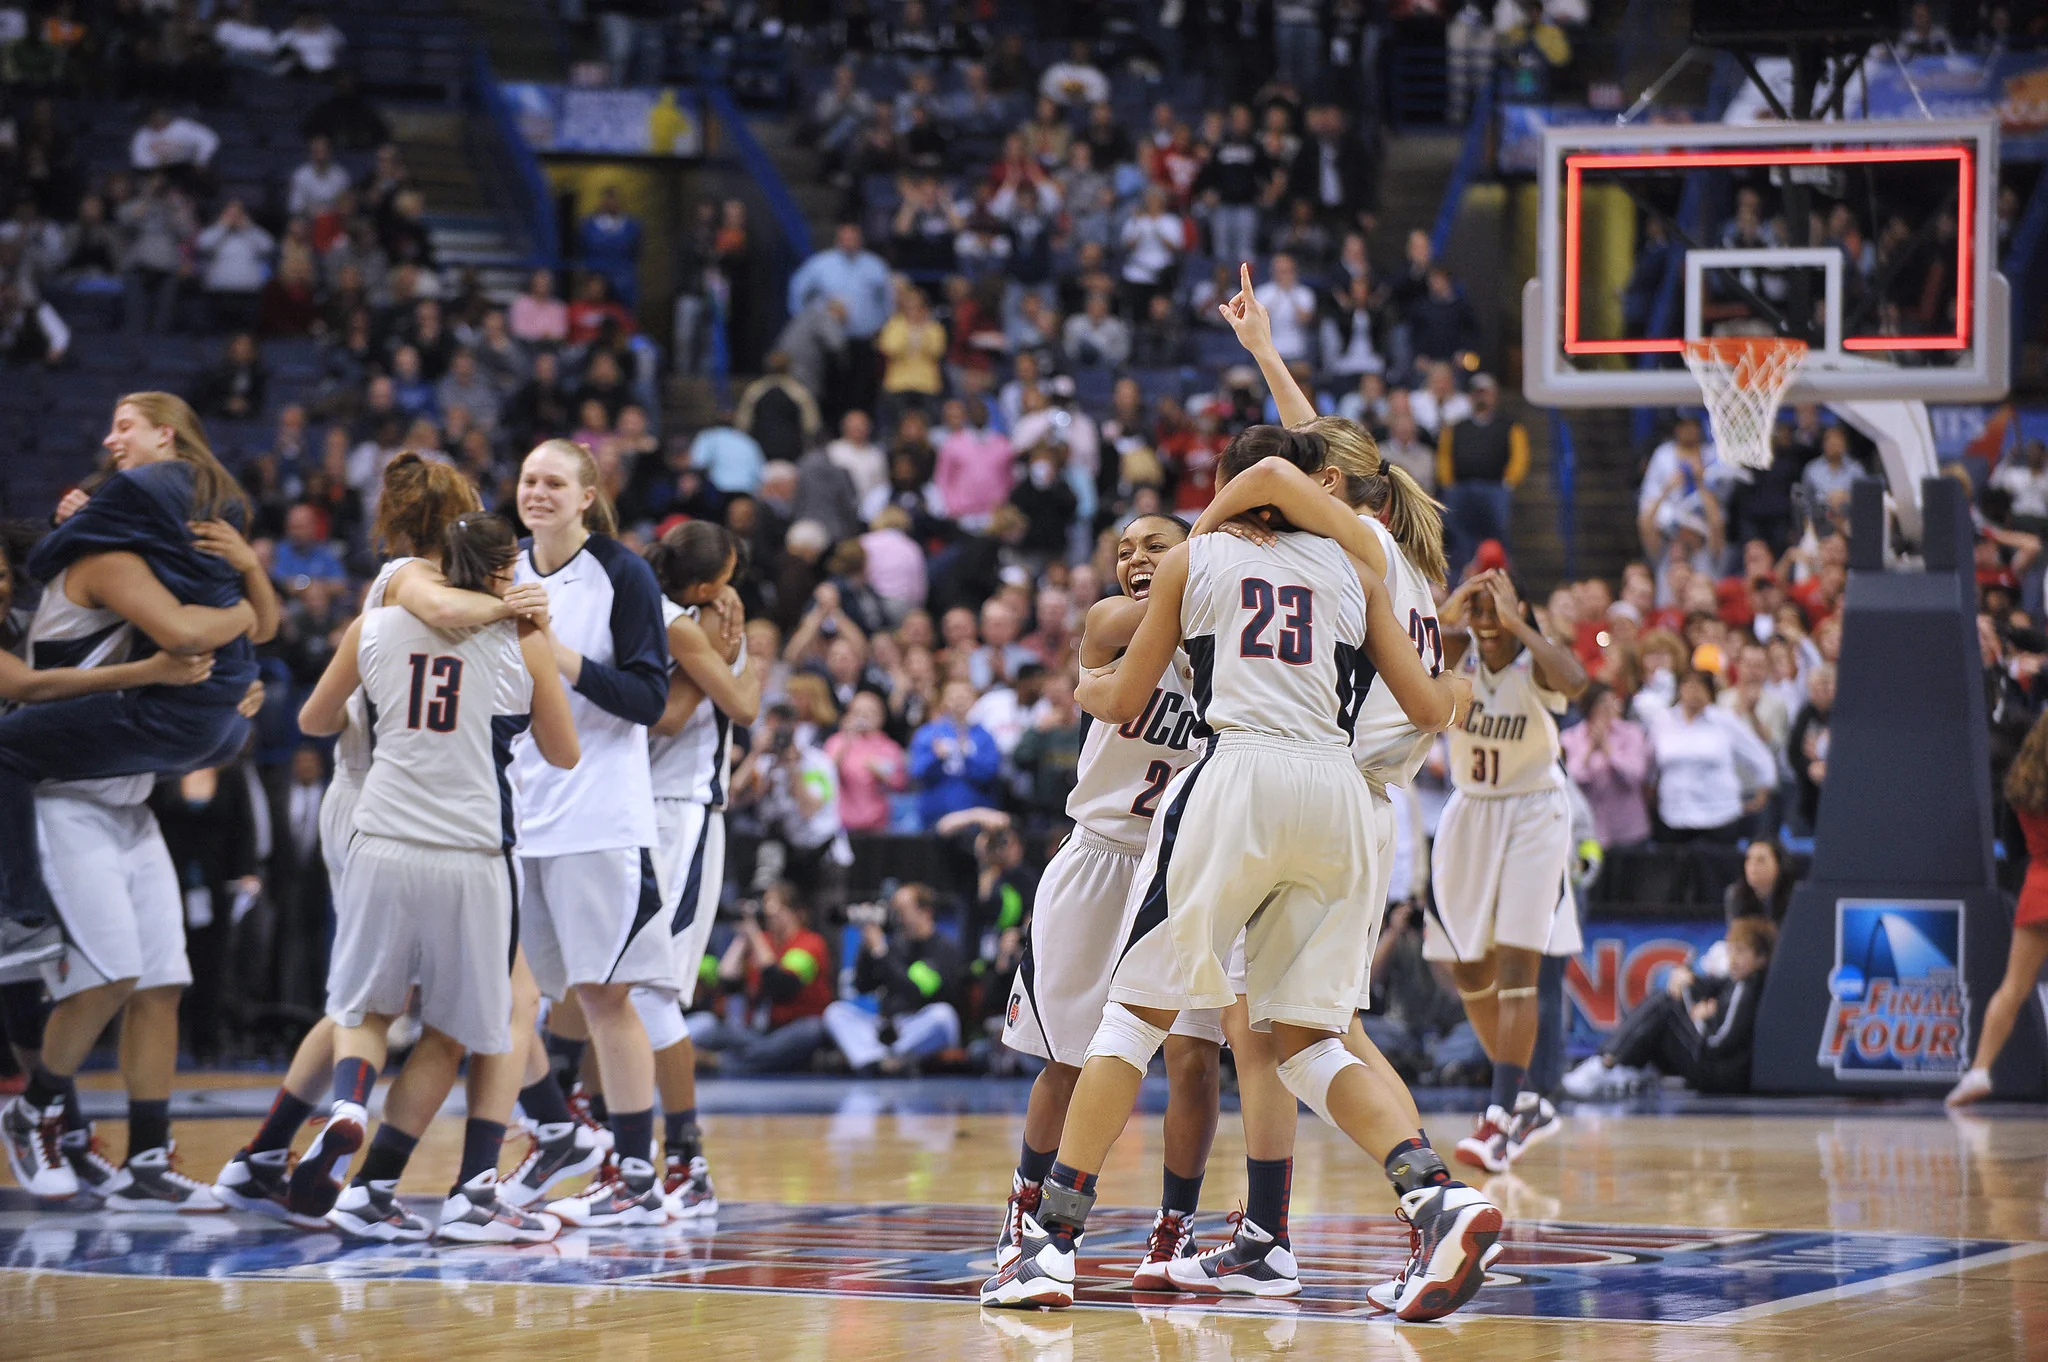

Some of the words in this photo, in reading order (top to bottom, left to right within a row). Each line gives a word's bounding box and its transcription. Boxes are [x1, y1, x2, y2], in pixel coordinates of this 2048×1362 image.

[1239, 577, 1314, 666] 23
[407, 652, 464, 733] 13
[1457, 700, 1528, 741] Conn
[1129, 759, 1189, 820] 2
[1472, 747, 1500, 787] 31
[1868, 980, 1960, 1016] FINAL
[1830, 1008, 1959, 1057] FOUR
